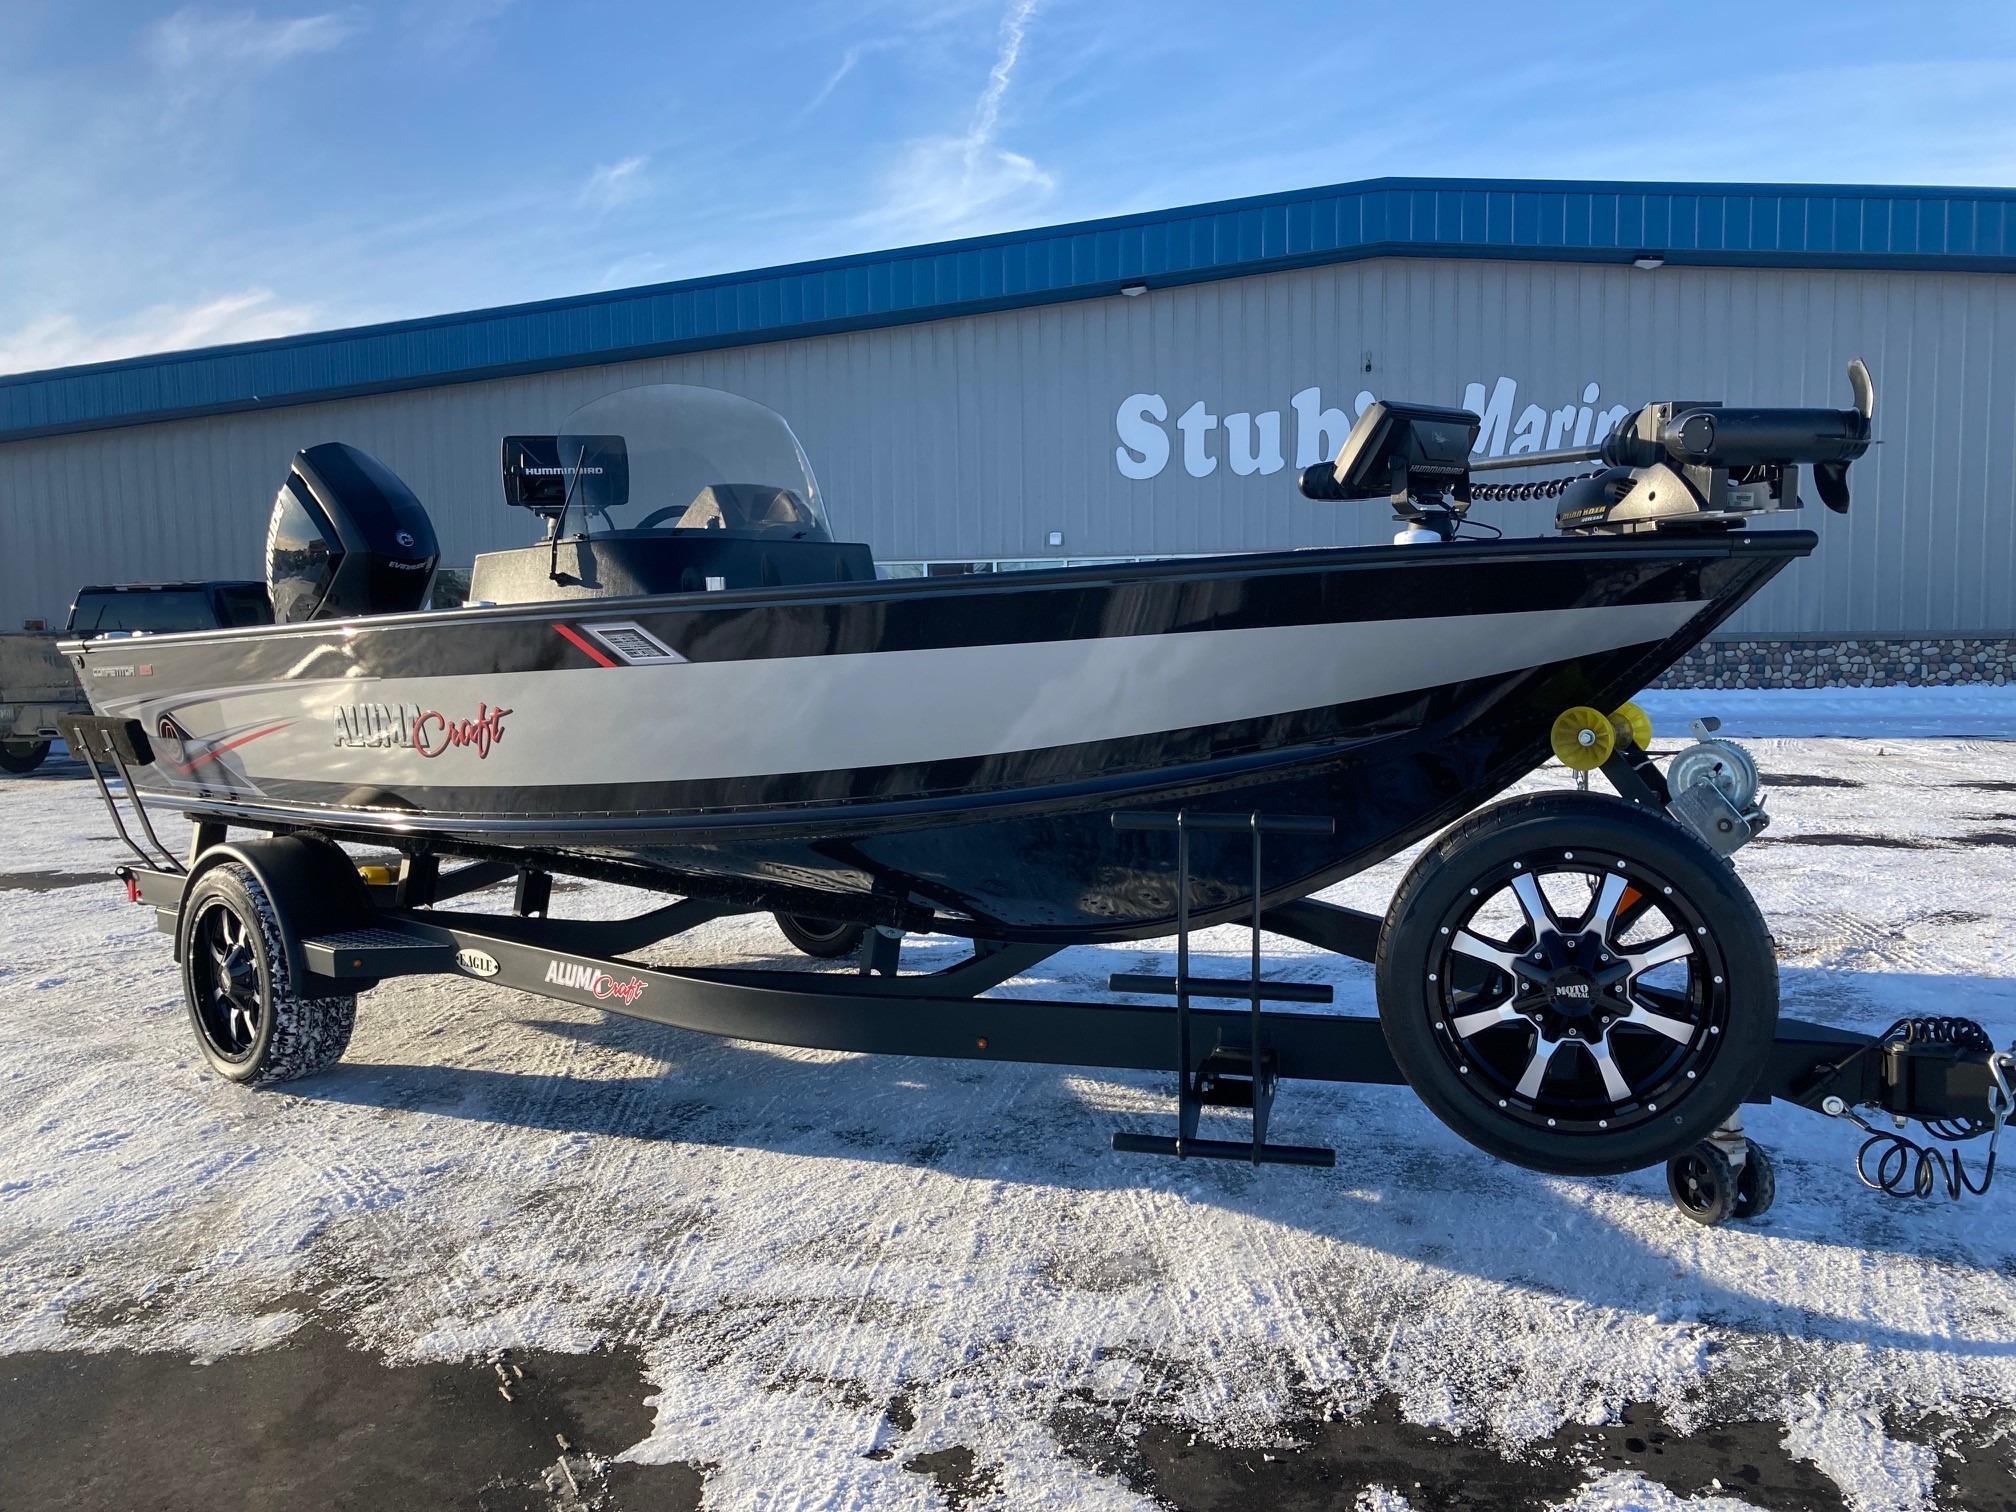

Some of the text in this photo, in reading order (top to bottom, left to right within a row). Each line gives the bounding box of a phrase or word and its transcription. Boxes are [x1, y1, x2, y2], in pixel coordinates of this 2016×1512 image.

[1462, 376, 1650, 465] Marin
[1409, 464, 1464, 475] HUMMINBIRD
[459, 952, 493, 974] EAGLE
[1555, 984, 1590, 996] MOTO
